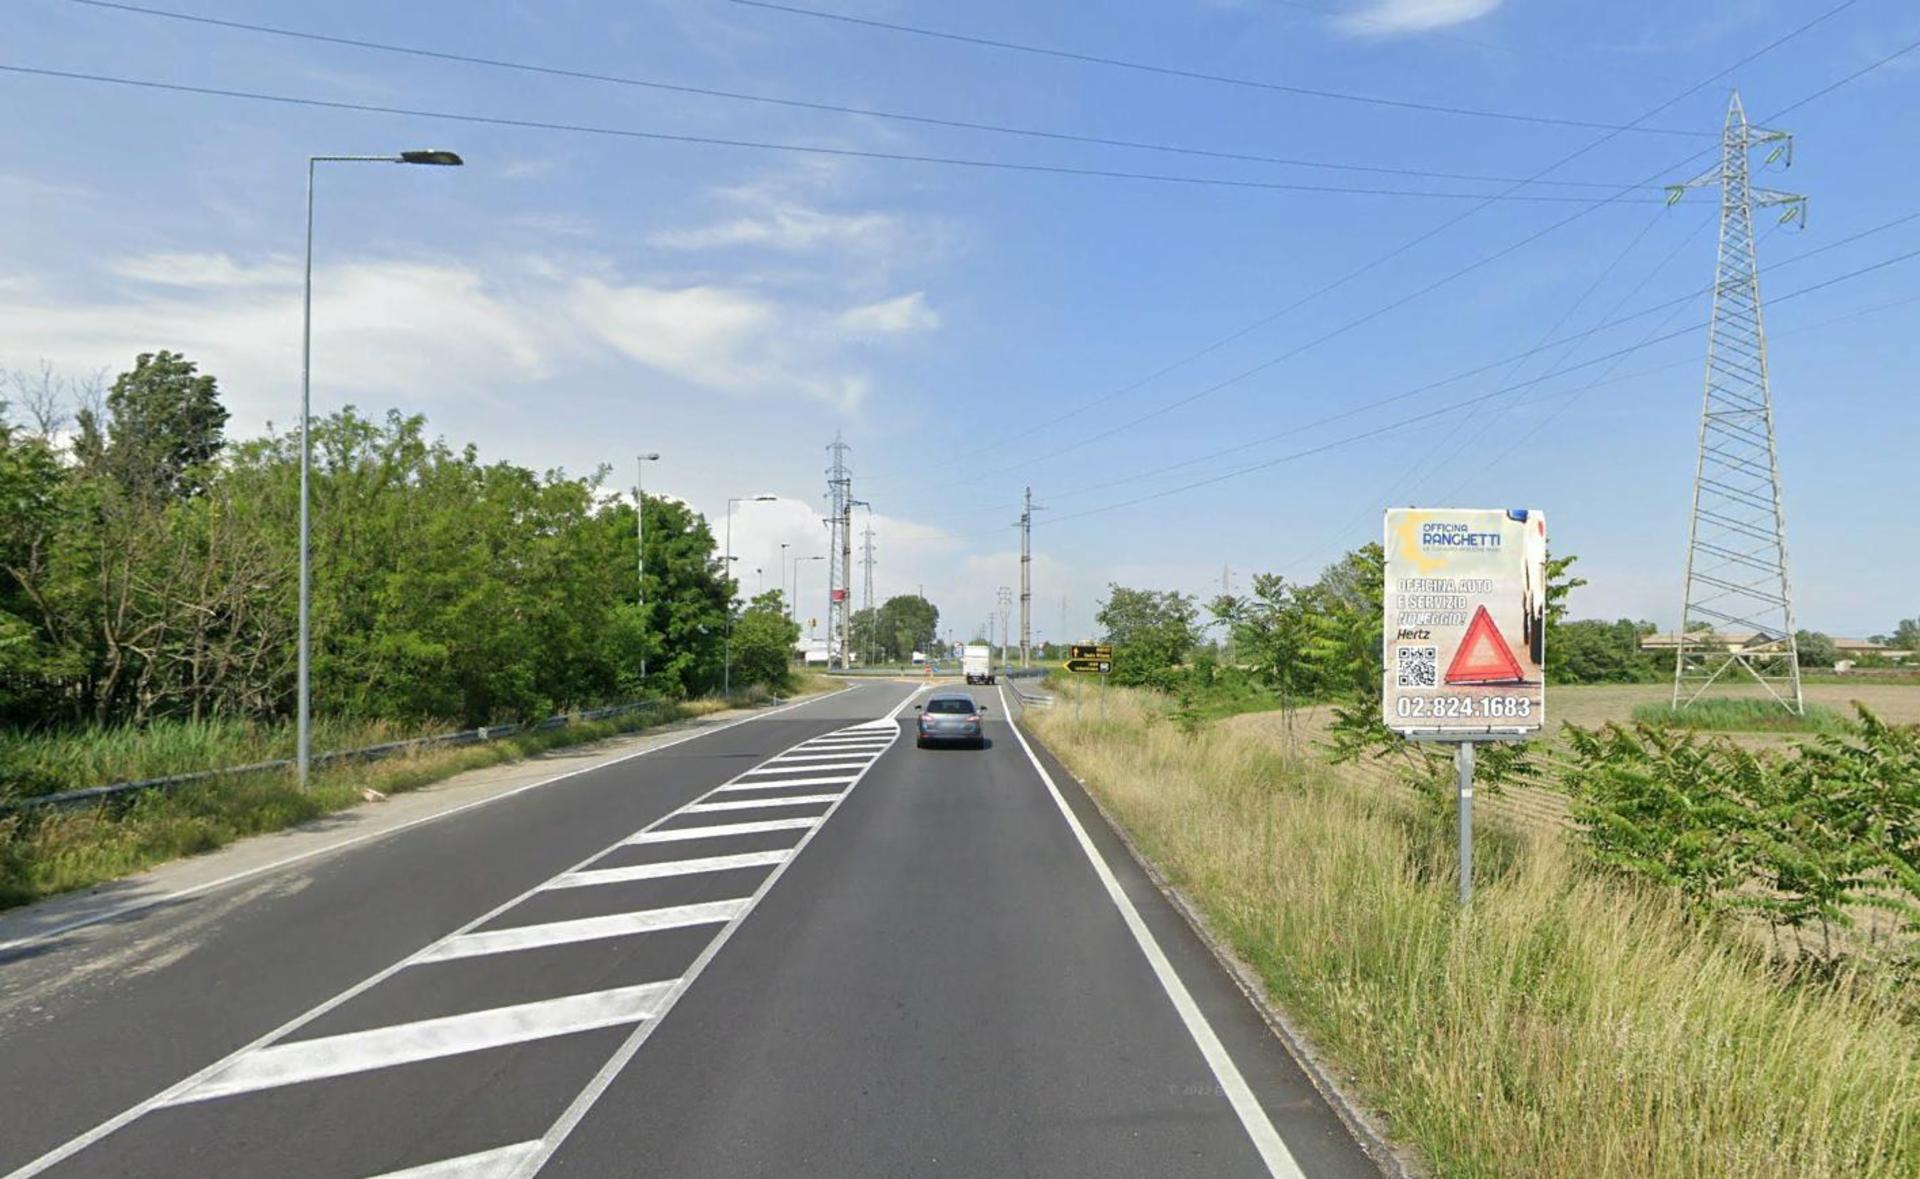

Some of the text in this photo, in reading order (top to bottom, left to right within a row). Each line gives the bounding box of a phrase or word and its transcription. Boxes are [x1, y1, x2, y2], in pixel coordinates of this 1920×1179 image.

[1422, 523, 1468, 532] OFFICINA
[1422, 533, 1501, 546] RANGHETTI
[1397, 578, 1493, 593] OFFICINA AUTO
[1397, 594, 1467, 609] E SERVIZIO
[1397, 628, 1431, 640] Hertz
[1397, 695, 1531, 717] 02.824.1683
